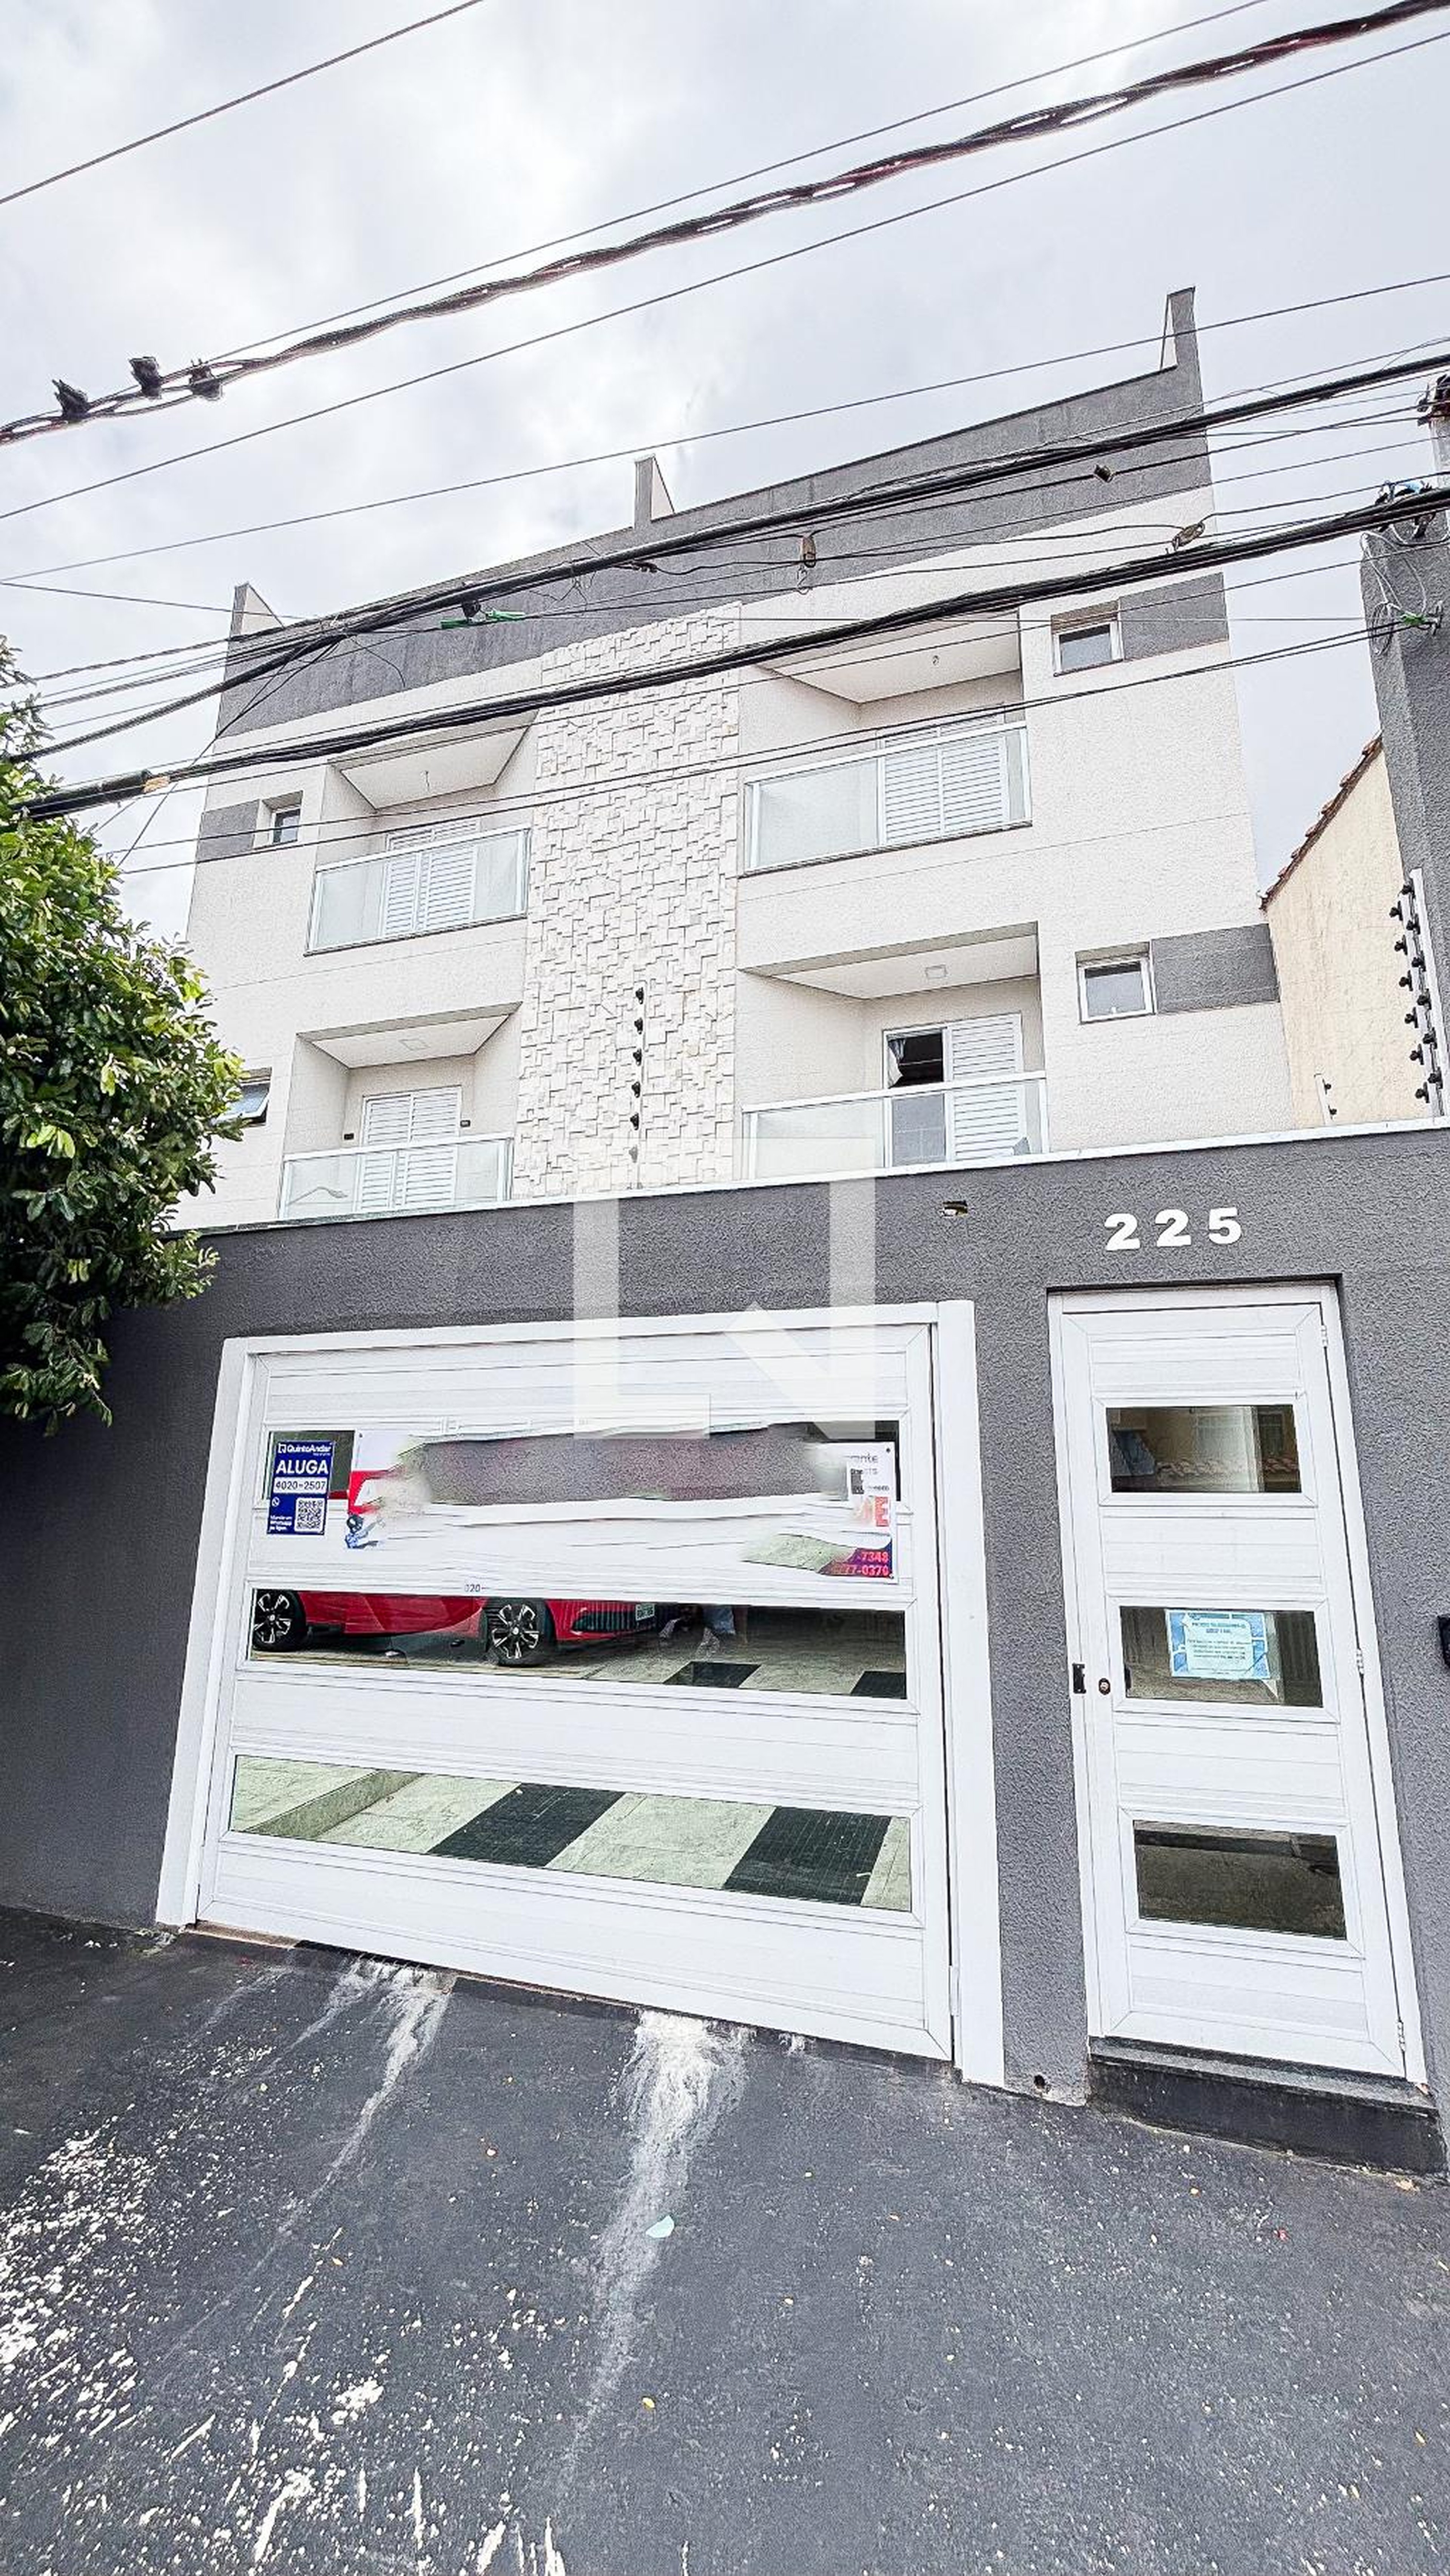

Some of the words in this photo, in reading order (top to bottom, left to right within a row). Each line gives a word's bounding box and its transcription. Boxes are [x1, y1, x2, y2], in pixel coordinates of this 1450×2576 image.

[1104, 1208, 1242, 1251] 225
[287, 1444, 331, 1452] QuintoAndar
[276, 1459, 329, 1474] ALUGA
[276, 1481, 326, 1490] 4020-2507
